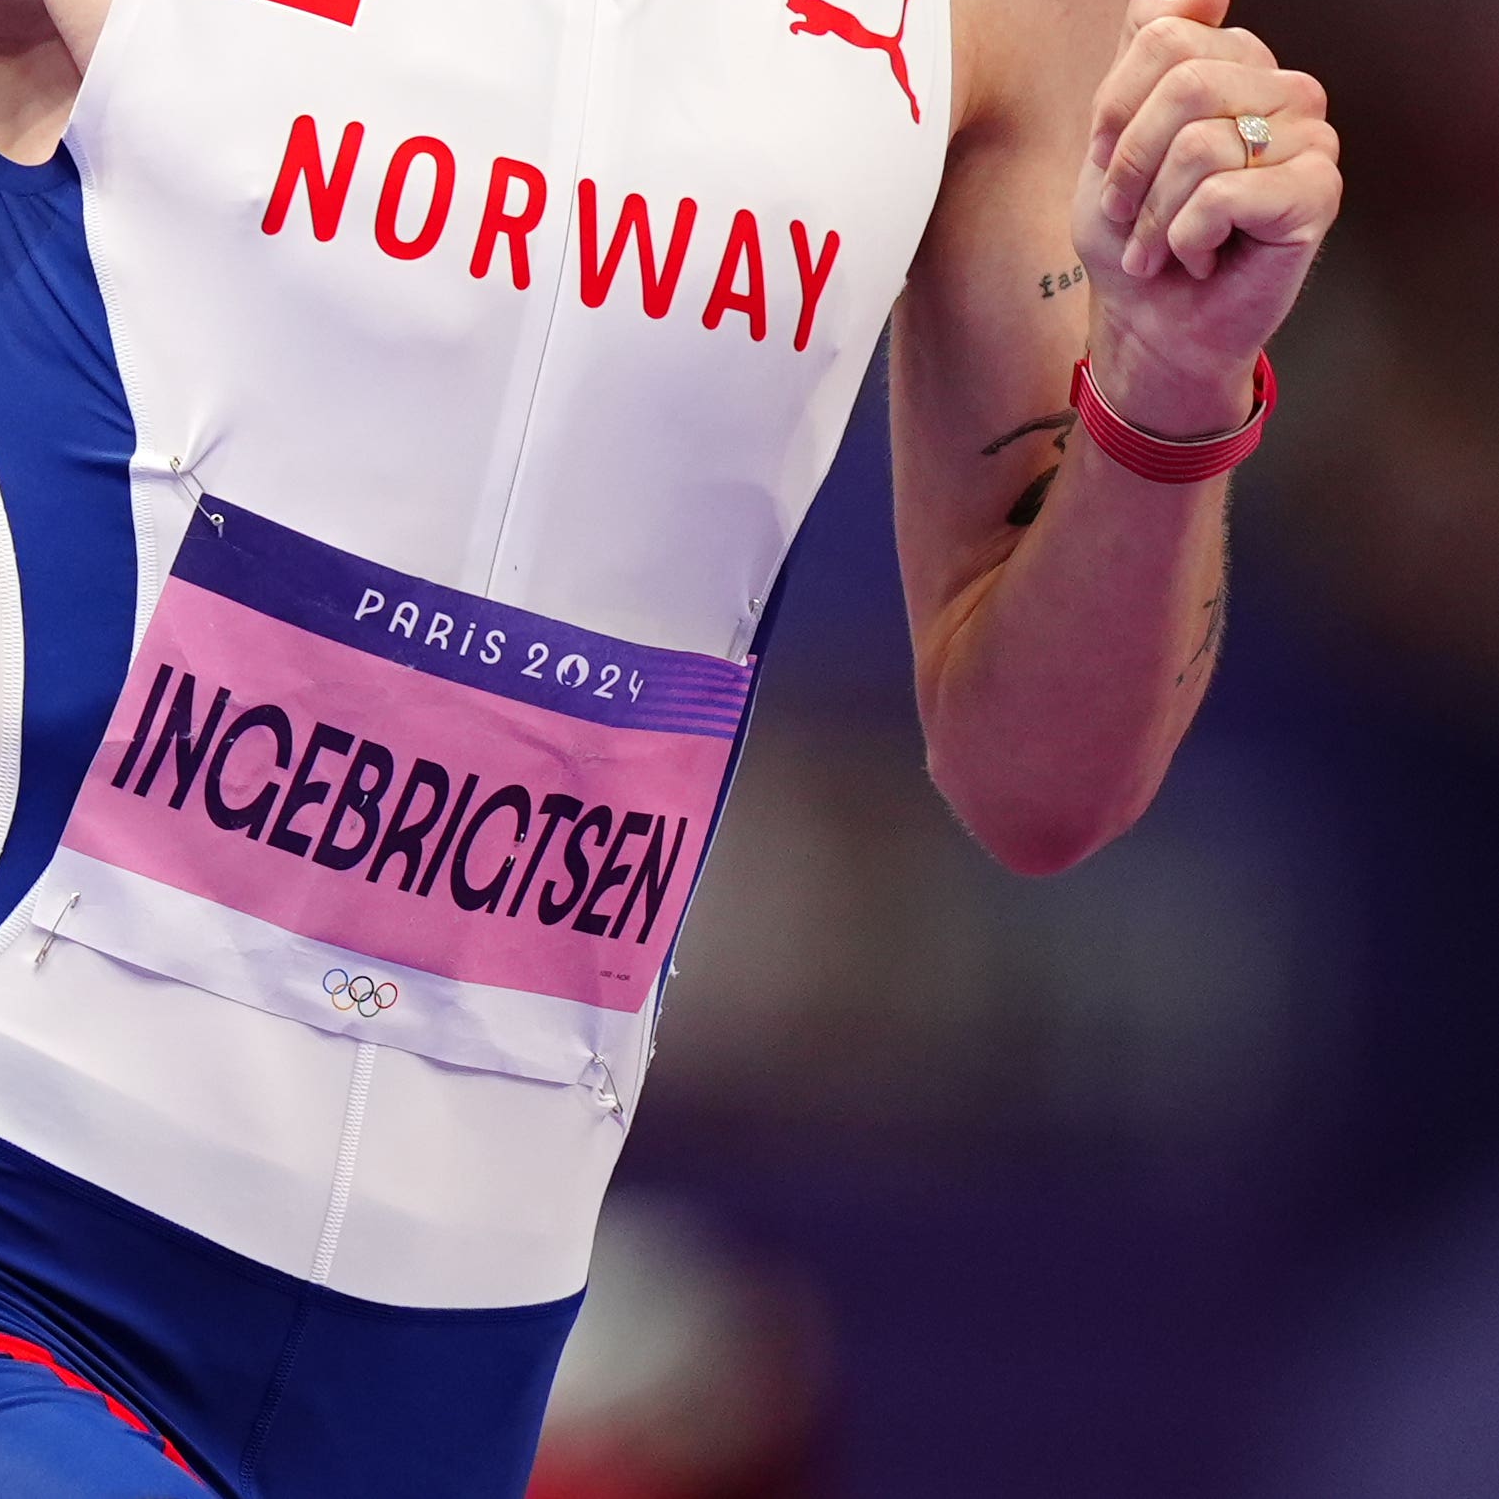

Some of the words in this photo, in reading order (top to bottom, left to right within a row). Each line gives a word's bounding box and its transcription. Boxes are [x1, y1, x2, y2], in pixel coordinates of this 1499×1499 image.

[261, 114, 840, 353] NORWAY
[520, 642, 644, 703] 2024
[110, 663, 689, 945] INGEBRIGTSEN
